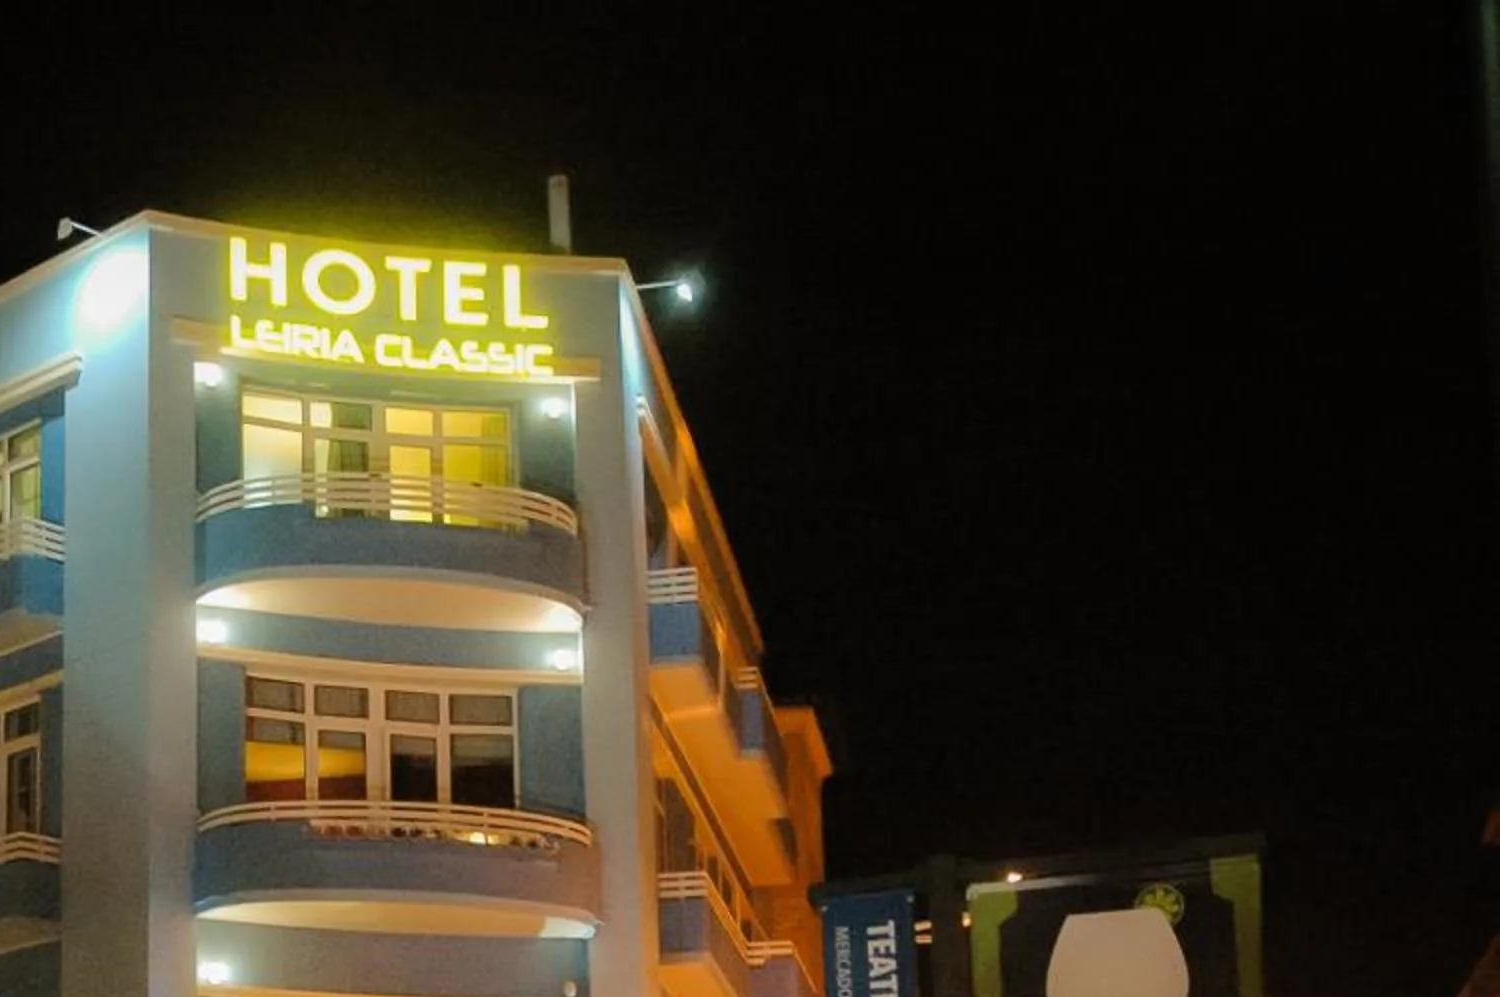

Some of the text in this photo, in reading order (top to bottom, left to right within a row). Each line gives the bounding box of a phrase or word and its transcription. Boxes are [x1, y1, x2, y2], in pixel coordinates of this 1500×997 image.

[229, 237, 549, 328] HOTEL
[230, 315, 555, 376] LEIRIA CLASSIC
